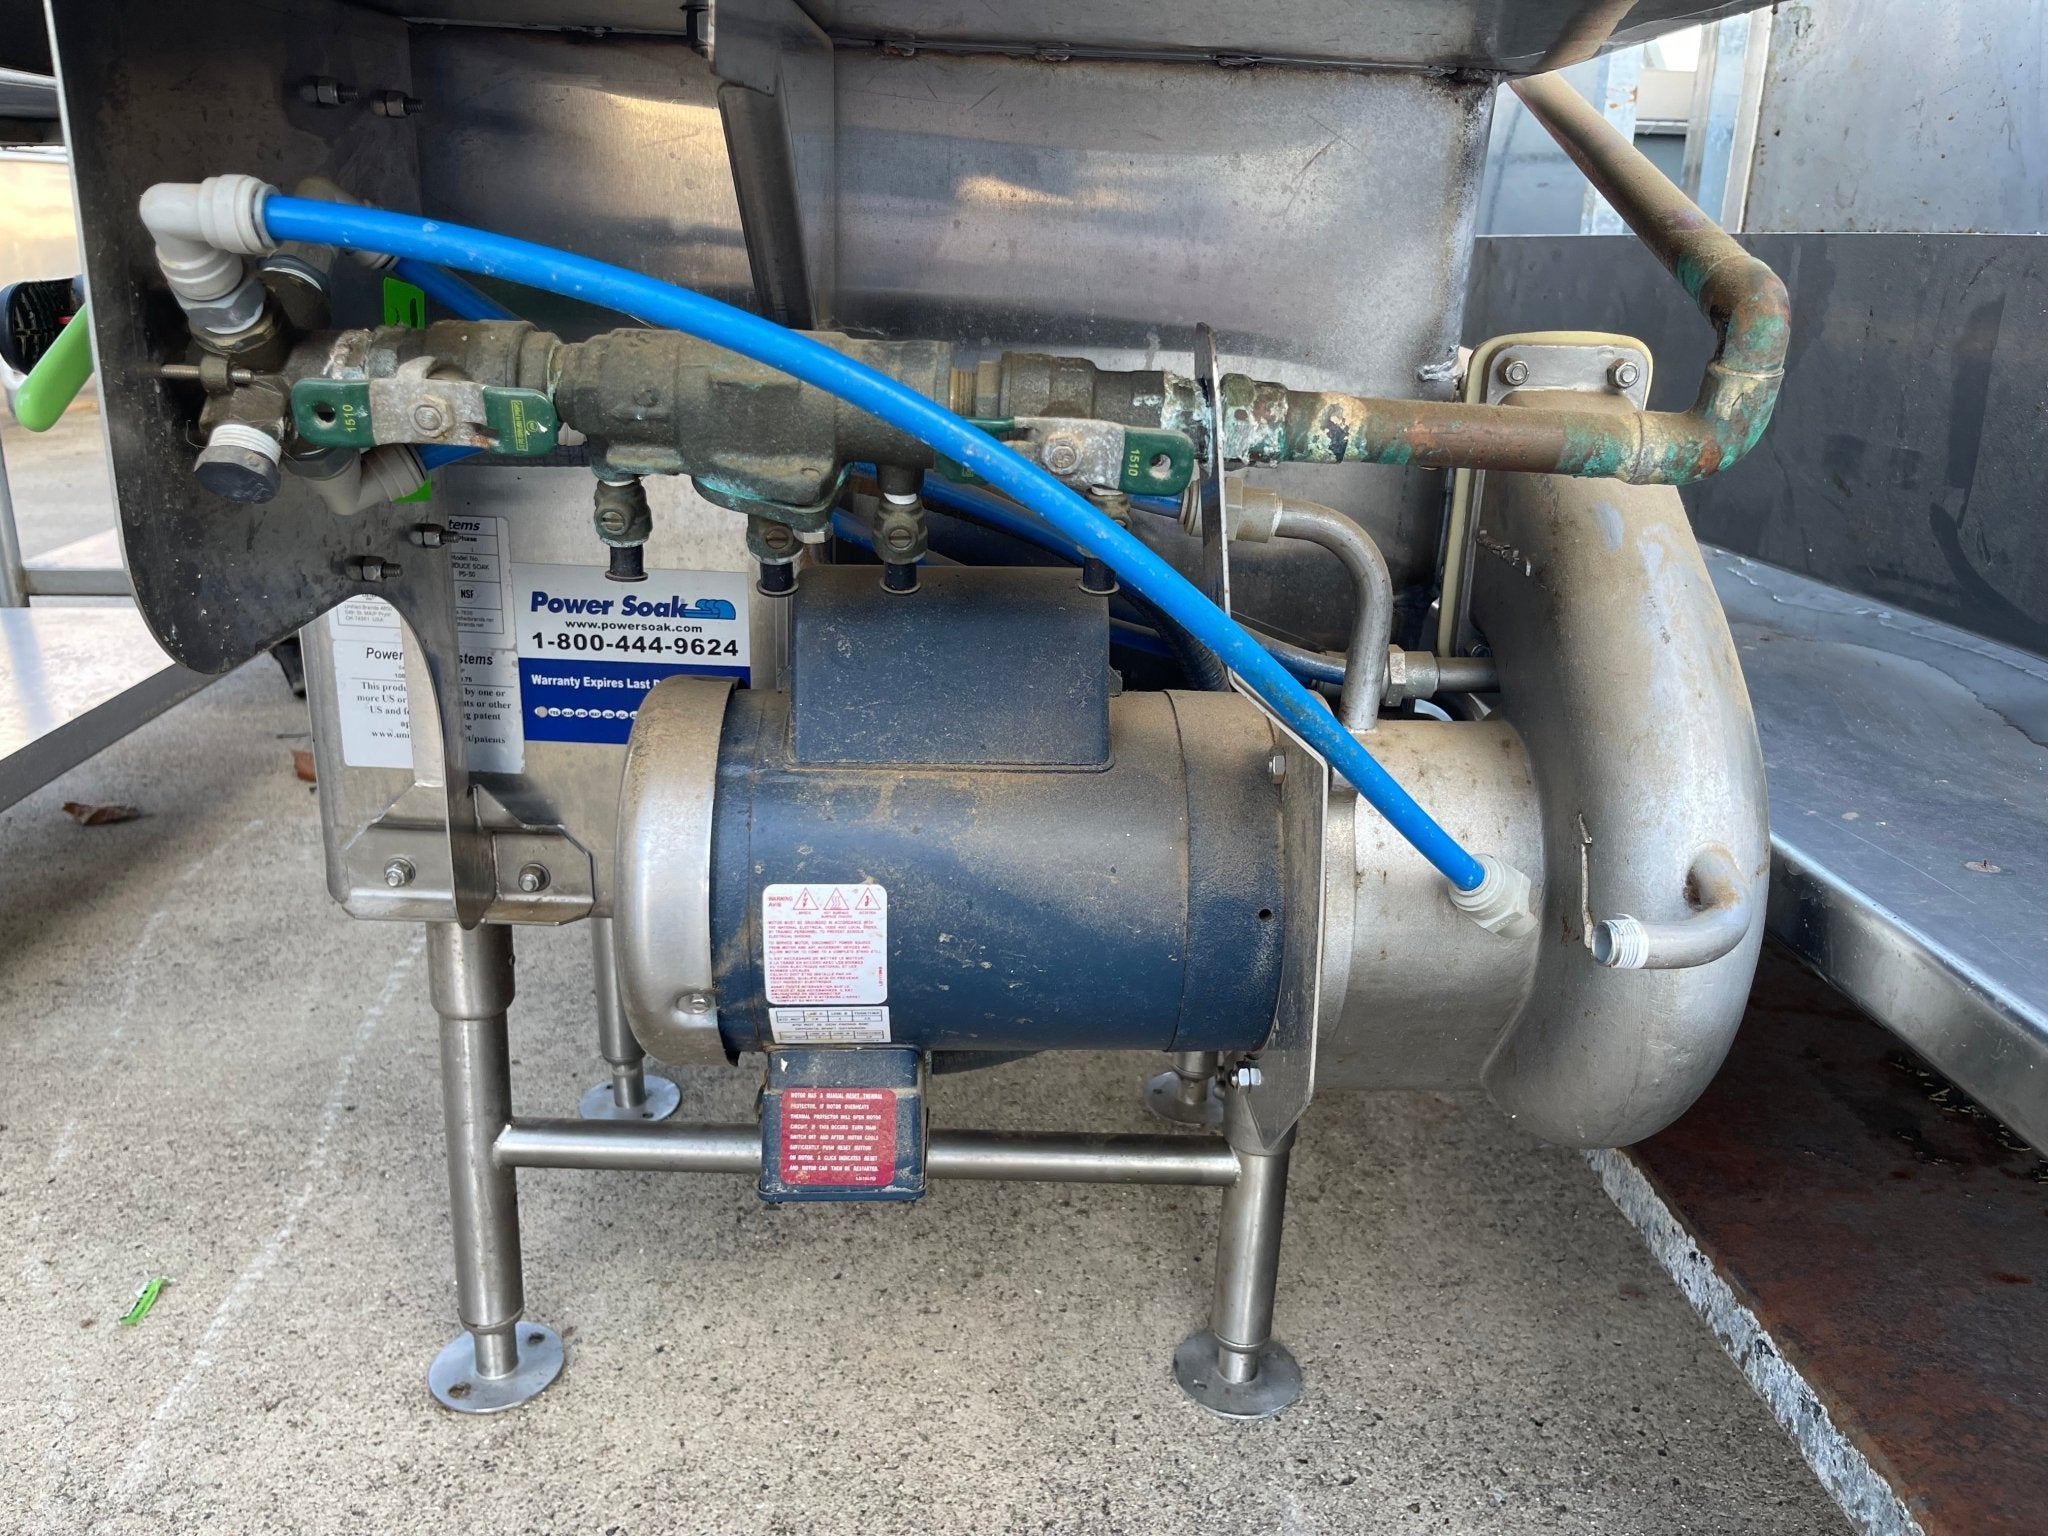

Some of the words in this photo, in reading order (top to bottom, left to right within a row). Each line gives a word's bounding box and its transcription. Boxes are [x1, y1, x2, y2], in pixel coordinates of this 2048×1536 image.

[342, 404, 355, 433] 1510
[1128, 449, 1140, 477] 1510
[448, 519, 480, 531] tems
[460, 589, 475, 599] NSF
[530, 591, 614, 615] Power
[621, 595, 688, 618] Soak
[565, 620, 703, 633] www.powersoak.com
[532, 632, 739, 656] 1-800-444-9624
[366, 647, 404, 661] Power
[459, 653, 493, 665] stems
[362, 682, 380, 690] This
[382, 683, 406, 692] produ
[465, 688, 475, 696] by
[531, 674, 581, 689] Warranty
[583, 676, 624, 689] Expires
[626, 678, 651, 689] Last
[382, 694, 395, 703] US
[488, 701, 511, 709] other
[370, 705, 383, 714] US
[385, 707, 401, 715] and
[474, 712, 501, 720] patent
[372, 731, 410, 739] www.uni
[465, 735, 506, 744] t/patents
